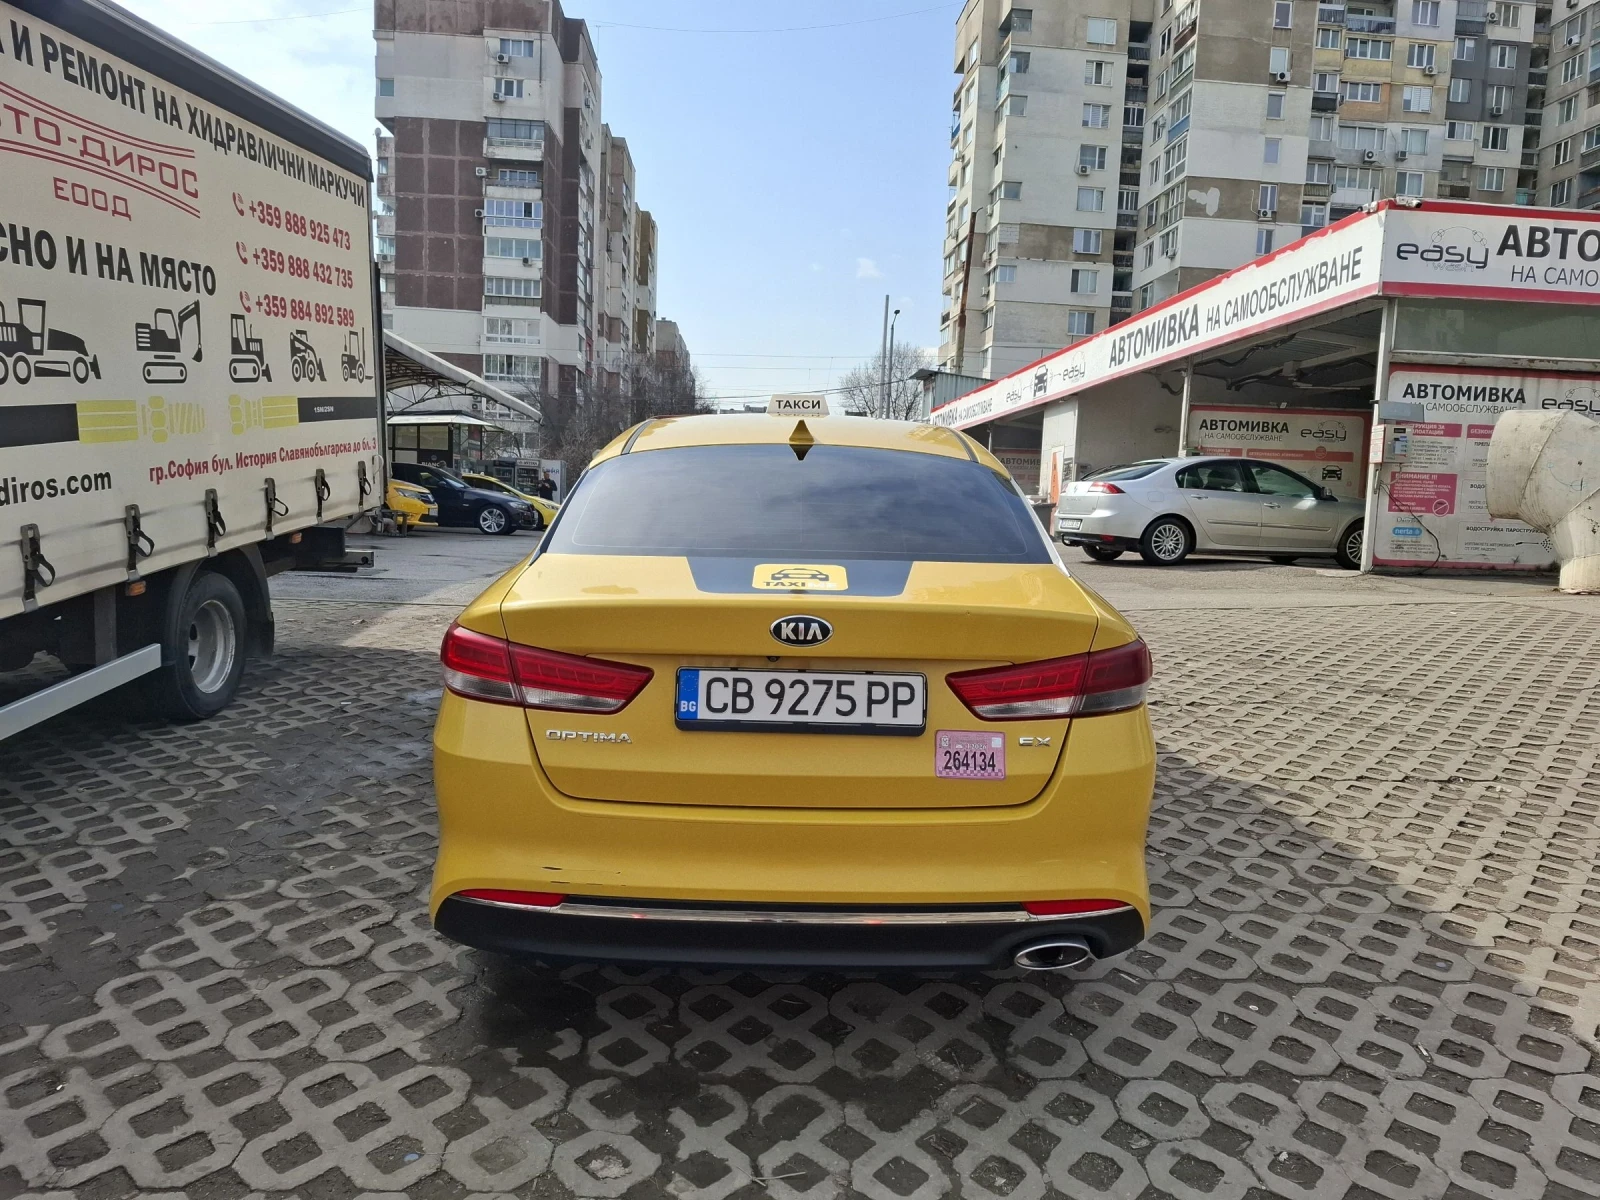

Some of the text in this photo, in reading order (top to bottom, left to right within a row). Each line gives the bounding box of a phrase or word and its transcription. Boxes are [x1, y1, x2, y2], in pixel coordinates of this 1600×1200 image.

[10, 19, 365, 208] И РЕМОНТ НА ХИДРАВЛИЧНИ МАРКУЧИ
[0, 104, 199, 199] ТО-ДИРОС
[53, 176, 132, 221] ЕООД
[249, 200, 351, 250] +359 888 925 473
[1496, 224, 1600, 262] АВТО
[66, 236, 88, 276] И
[95, 242, 134, 284] НА
[139, 251, 216, 296] МЯСТО
[252, 247, 353, 289] +359 888 432 735
[1396, 243, 1489, 269] easy
[1511, 265, 1599, 287] НА САМО
[256, 294, 355, 328] +359 884 892 589
[1109, 246, 1362, 368] АВТОМИВКА НА САМООБСЛУЖВАНЕ
[1063, 362, 1086, 381] easy
[776, 400, 821, 409] ТАКСИ
[1402, 383, 1527, 404] АВТОМИВКА
[1199, 419, 1290, 434] АВТОМИВКА
[1216, 433, 1283, 442] САМООБСЛУЖВАНЕ
[1300, 428, 1347, 441] easy
[149, 459, 209, 485] гр.София
[211, 454, 233, 475] бул.
[235, 451, 277, 471] История
[279, 442, 352, 462] Славянобългарска
[353, 441, 361, 454] до
[362, 437, 371, 450] бл.
[1001, 457, 1041, 466] АВТОМИВ
[780, 622, 823, 640] KIA
[680, 677, 916, 718] BG CB 9275 PP
[546, 729, 633, 743] OPTIMA
[1019, 736, 1052, 747] EX
[944, 750, 996, 771] 264134
